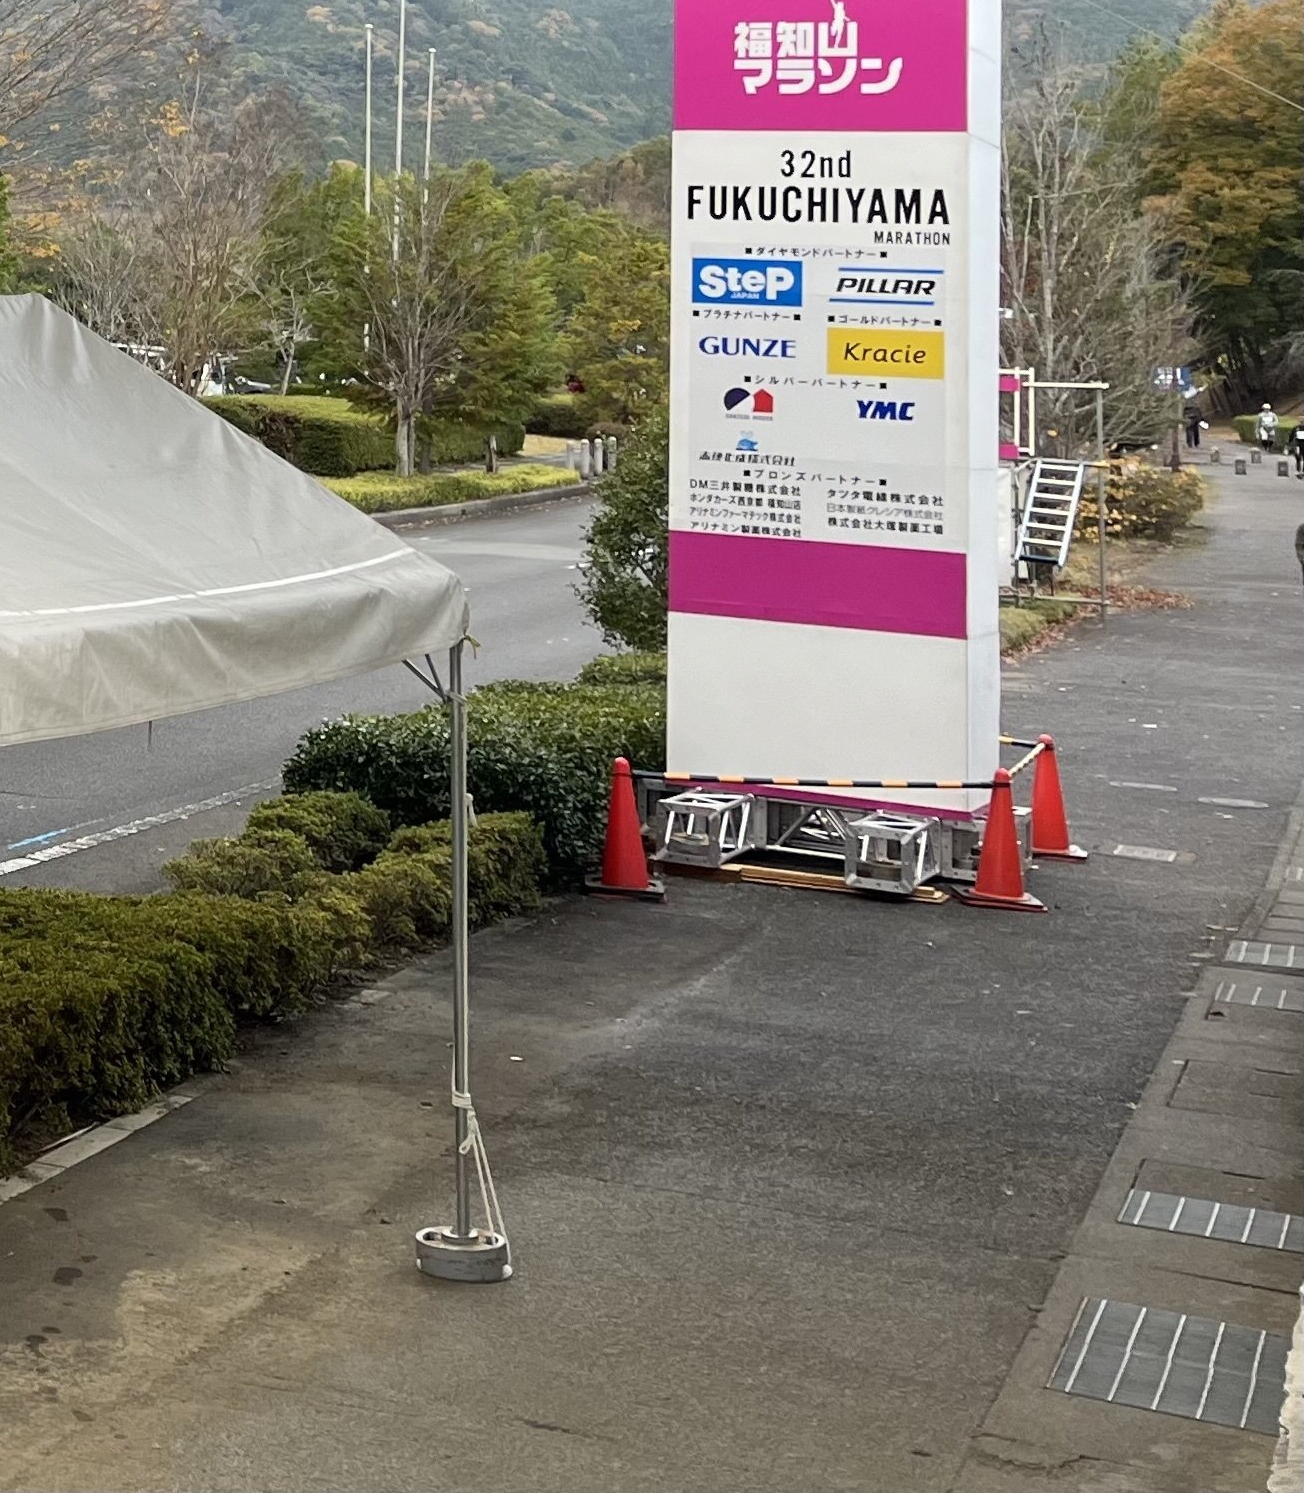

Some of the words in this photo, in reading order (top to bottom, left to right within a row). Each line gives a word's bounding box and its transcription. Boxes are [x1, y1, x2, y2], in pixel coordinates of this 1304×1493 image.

[734, 10, 858, 58] 福知山
[733, 57, 903, 95] マラソン
[780, 149, 852, 179] 32nd
[687, 185, 951, 225] FUKUCHIYAMA
[873, 230, 951, 245] MARATHON
[730, 291, 760, 300] JAPAN
[836, 277, 936, 296] PILLAR
[703, 309, 790, 321] プラチナパートナー
[838, 314, 931, 326] ゴールドパートナー
[698, 336, 797, 358] GUNZE
[844, 342, 927, 364] Kracie
[754, 374, 876, 389] シルバーパートナー
[856, 400, 916, 421] YMC
[754, 469, 876, 485] ブロンズパートナー
